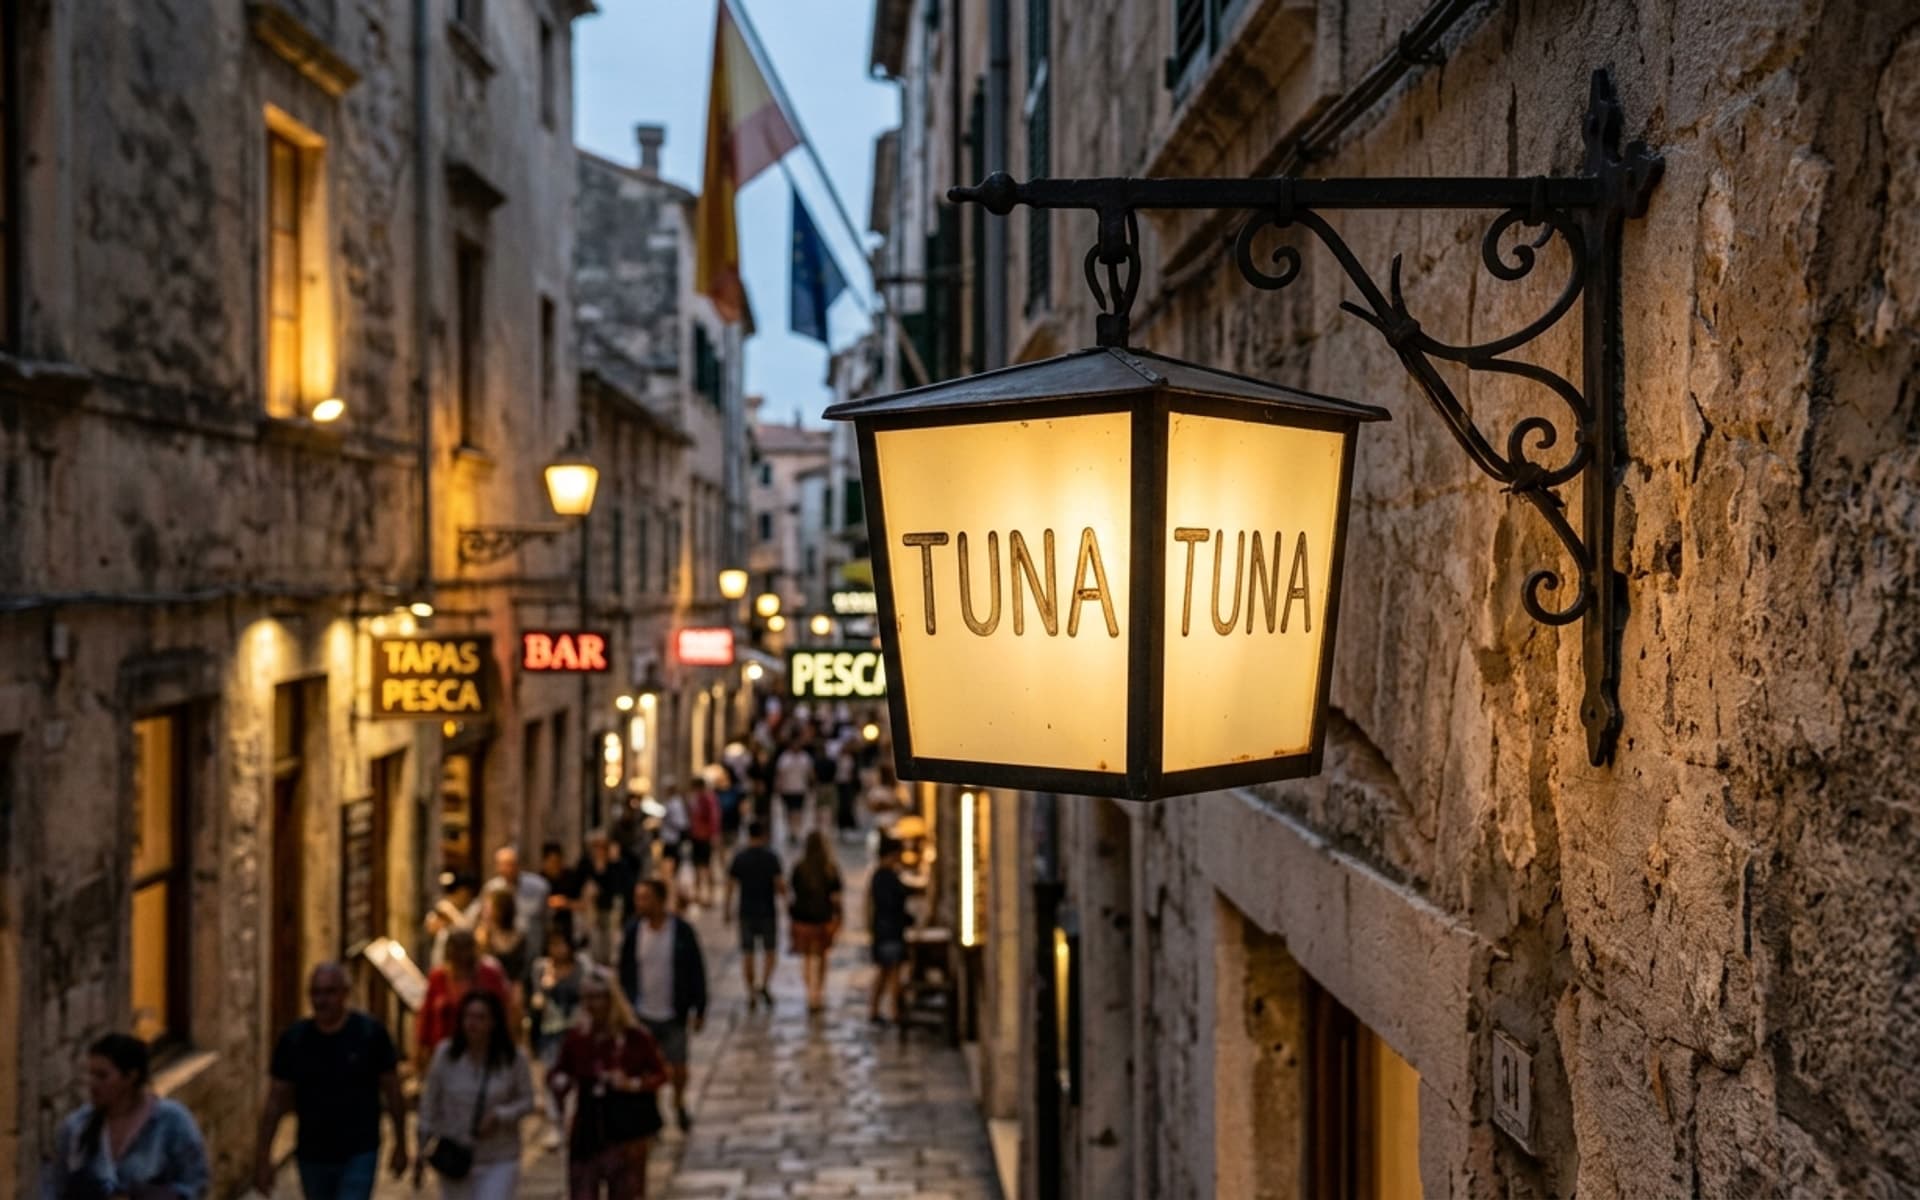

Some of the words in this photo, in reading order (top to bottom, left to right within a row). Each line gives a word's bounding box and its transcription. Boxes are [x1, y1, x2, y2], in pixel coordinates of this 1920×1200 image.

[902, 527, 1120, 638] TUNA
[1174, 527, 1312, 637] TUNA
[382, 640, 480, 674] TAPAS
[523, 633, 607, 670] BAR
[382, 678, 482, 712] PESCA
